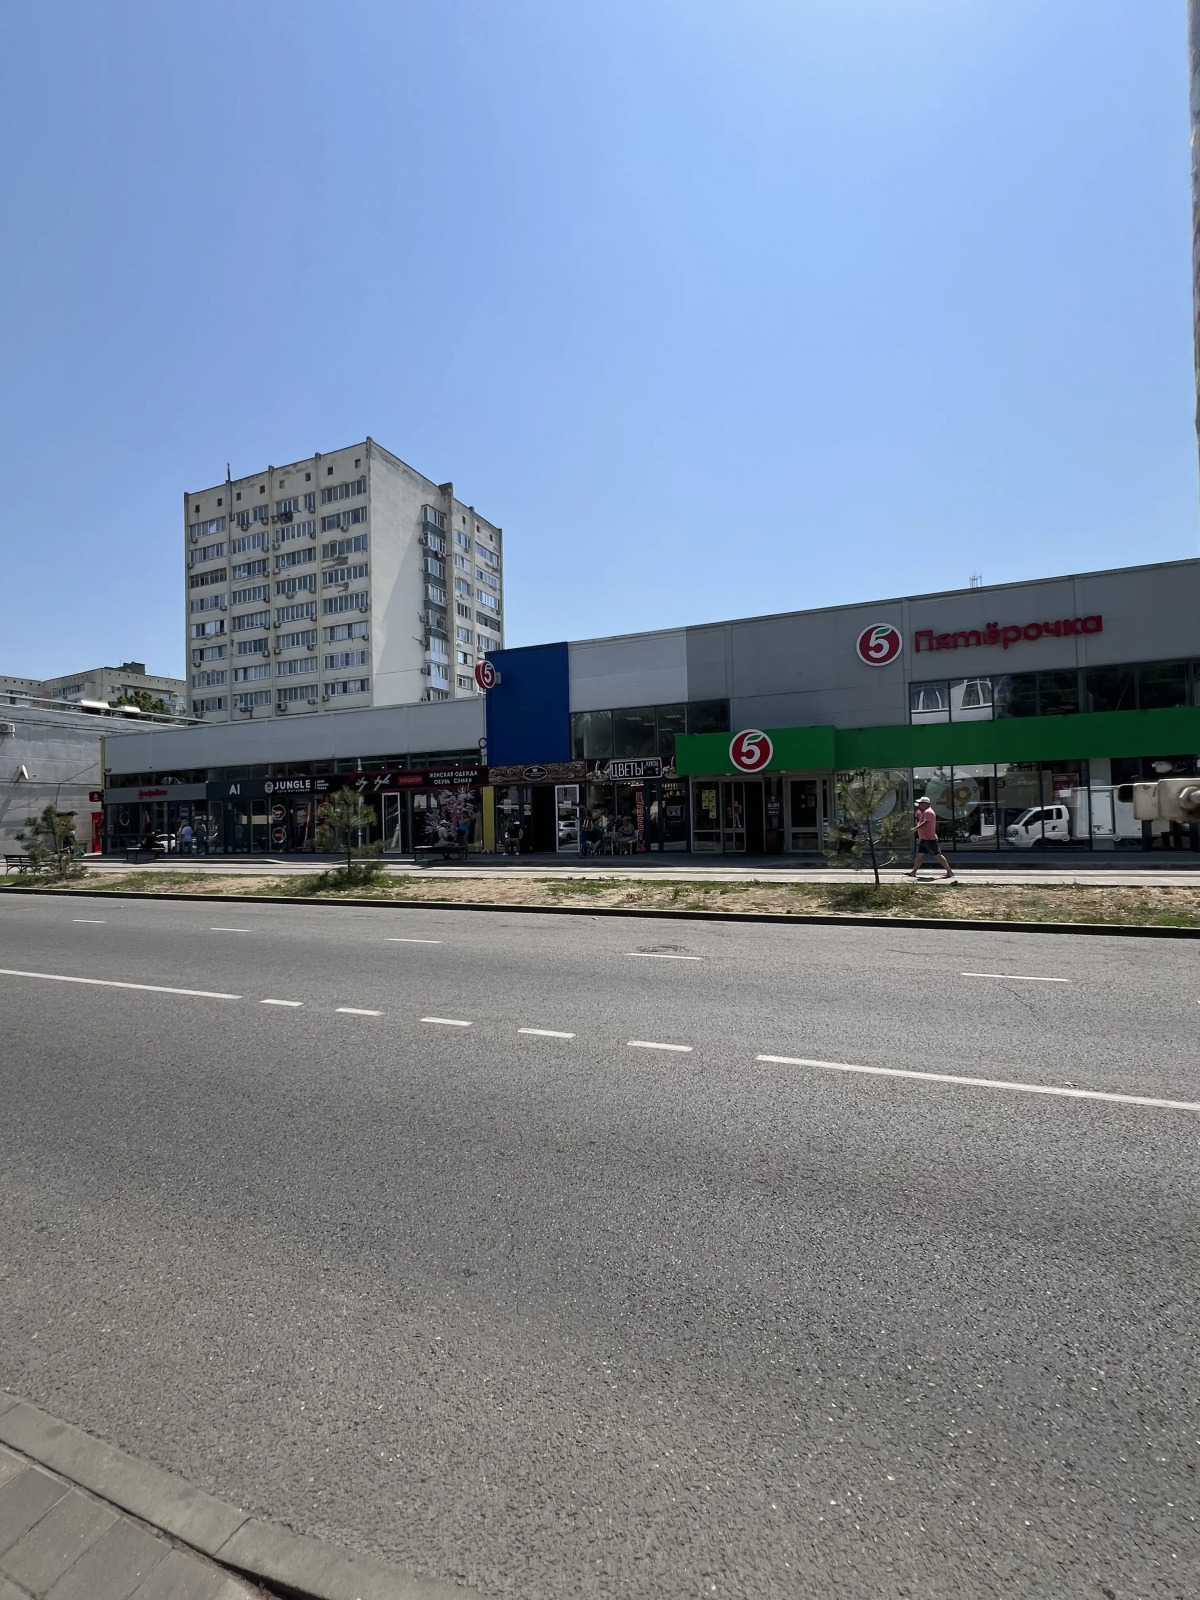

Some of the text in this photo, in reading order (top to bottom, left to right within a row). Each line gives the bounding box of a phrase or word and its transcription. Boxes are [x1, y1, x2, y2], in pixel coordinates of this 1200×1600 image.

[868, 625, 892, 659] 5
[914, 614, 1103, 653] Пятёрочка
[740, 733, 763, 765] 5
[274, 779, 311, 790] JUNGLE
[611, 761, 644, 778] ЦВЕТЫ
[635, 791, 646, 853] ЦВЕТЫ
